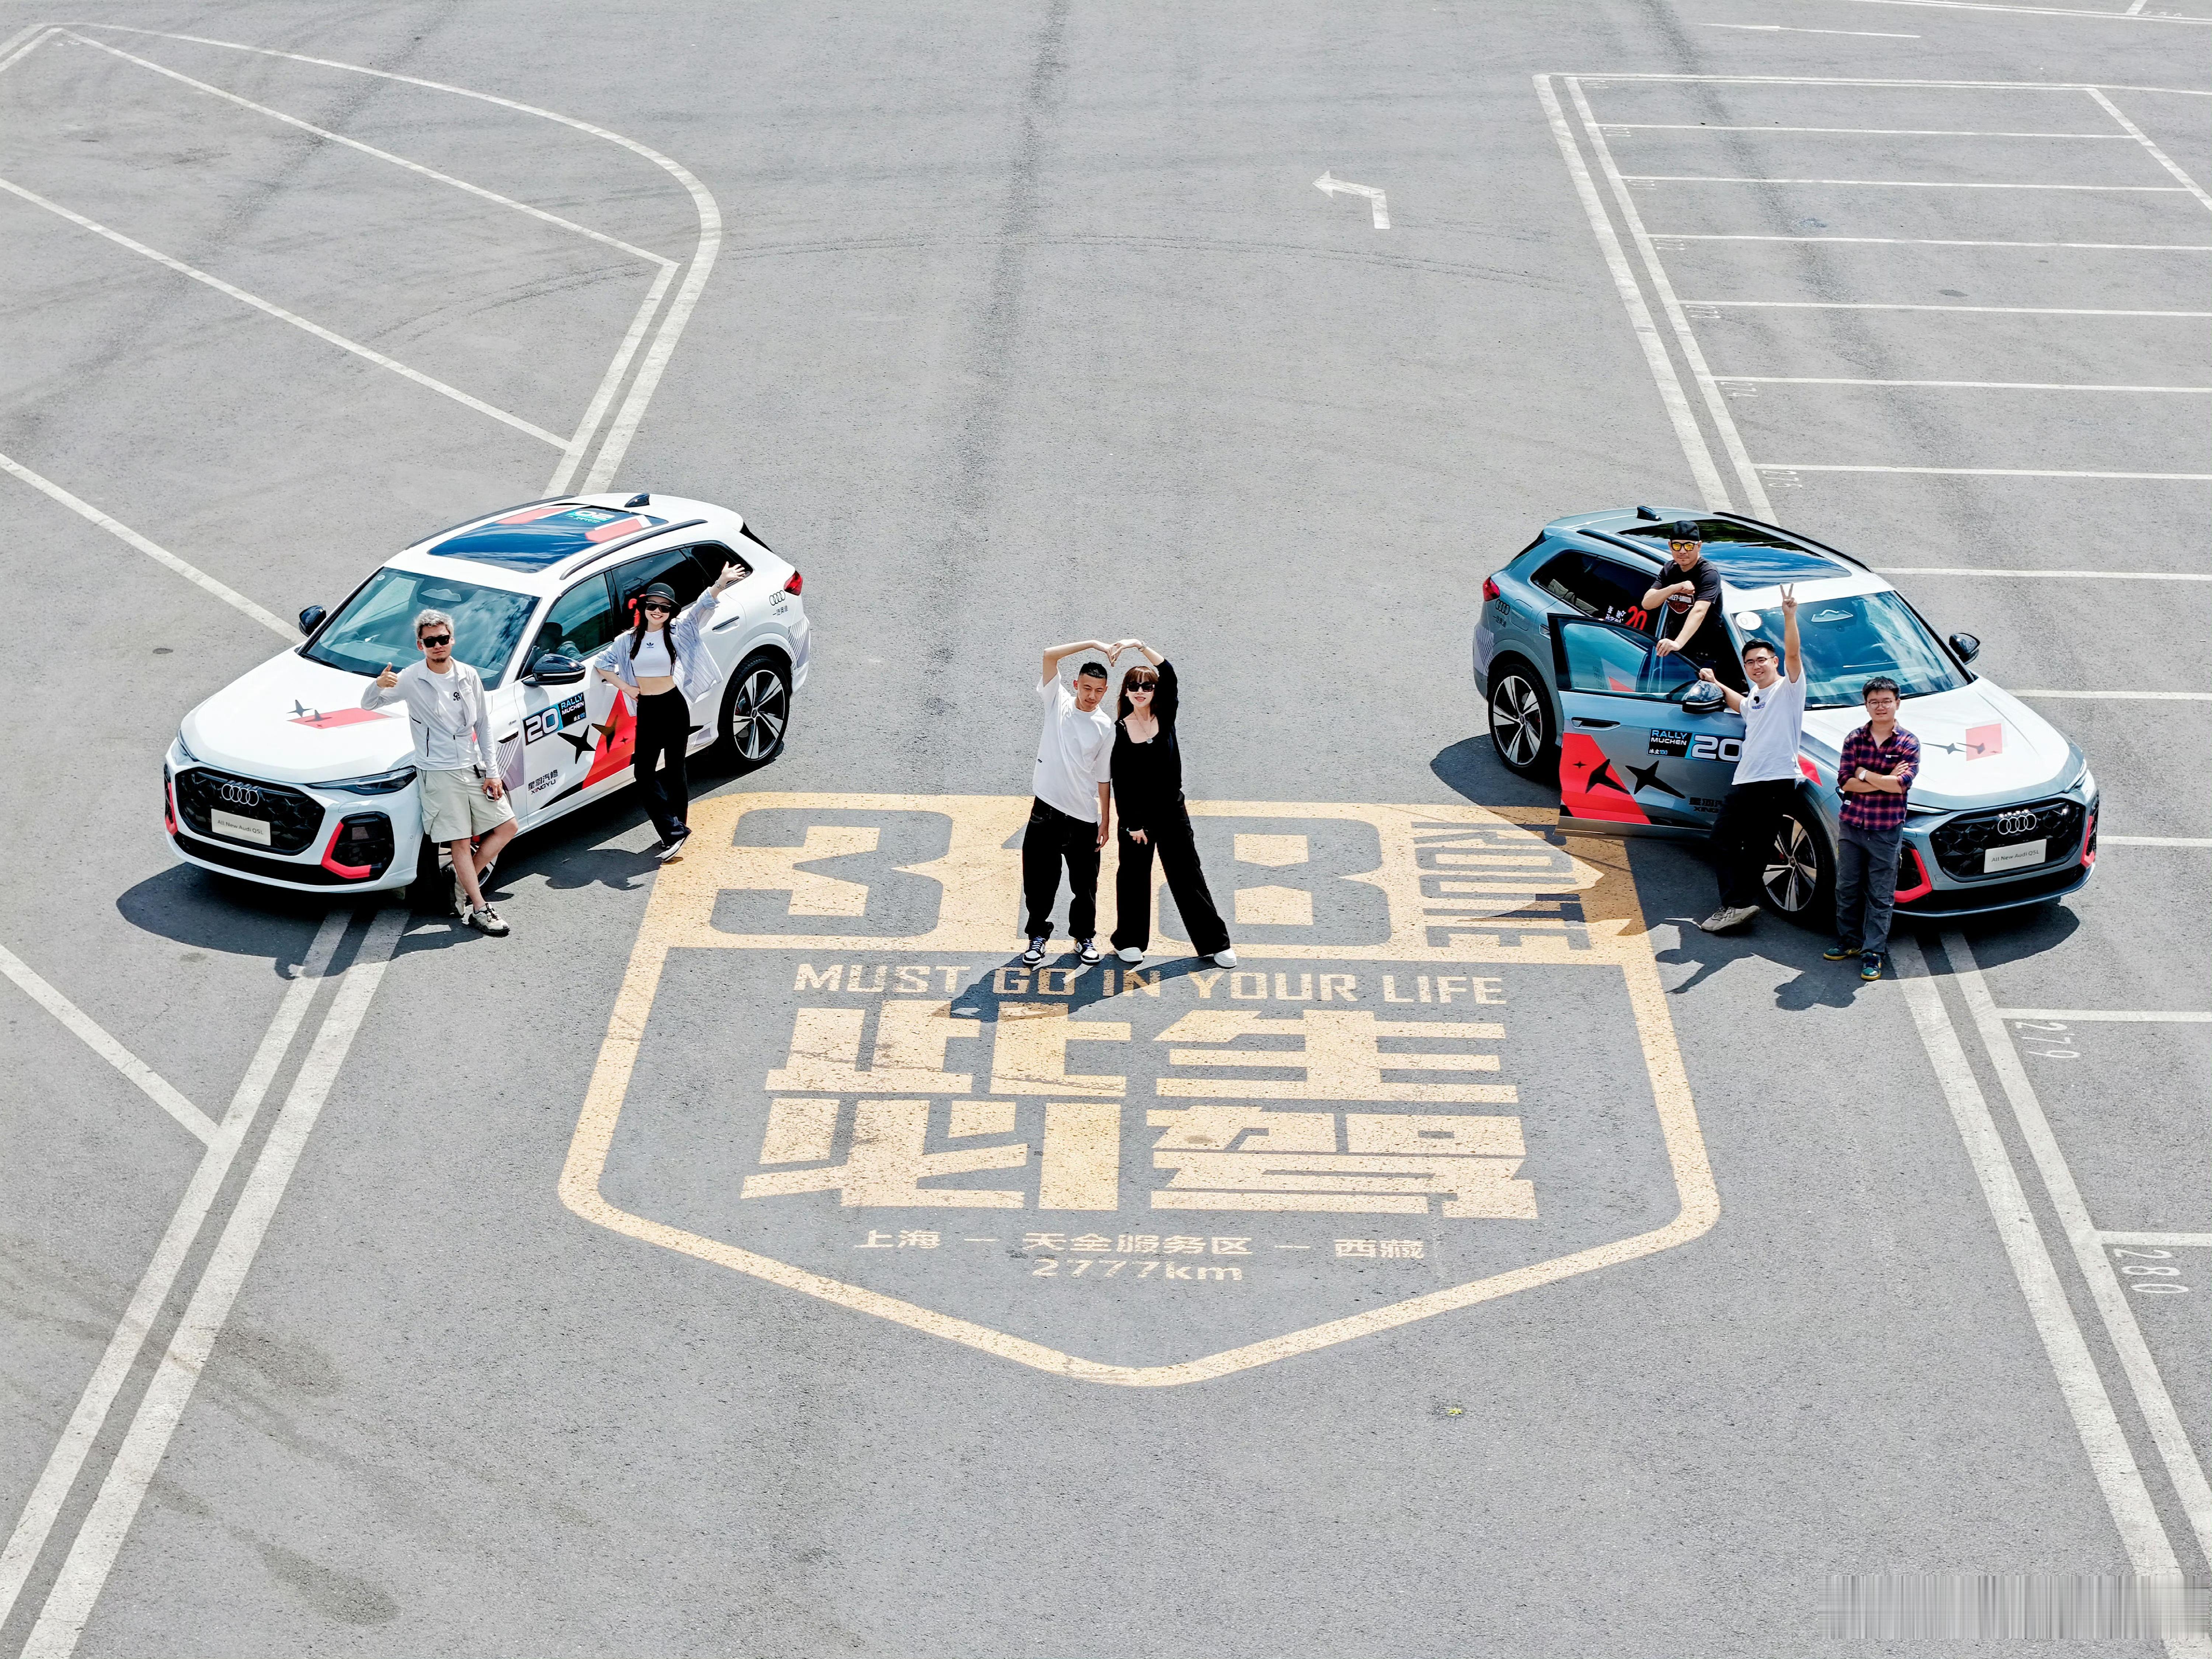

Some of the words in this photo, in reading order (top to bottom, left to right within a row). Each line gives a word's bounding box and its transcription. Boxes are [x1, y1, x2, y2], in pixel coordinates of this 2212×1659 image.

[1686, 305, 1721, 319] 273
[1720, 382, 1759, 397] 274
[1762, 470, 1803, 488] 275
[560, 693, 583, 709] RALLY
[561, 701, 584, 716] MUCHEN
[525, 708, 559, 742] 20
[1651, 730, 1687, 740] RALLY
[1651, 737, 1687, 745] MUCHEN
[1691, 735, 1743, 762] 20
[528, 769, 558, 791] 星羽汽修
[531, 779, 556, 795] XINGYU
[709, 807, 1393, 948] 38
[1410, 821, 1592, 950] ROUTE
[793, 963, 971, 993] MUST
[992, 967, 1076, 996] GO
[1103, 969, 1161, 998] IN
[1187, 971, 1359, 1002] YOUR
[1382, 975, 1508, 1005] LIFE
[2015, 1021, 2080, 1058] 279
[853, 1229, 942, 1249] 上海
[1022, 1232, 1252, 1255] 天全服务区
[1334, 1239, 1425, 1259] 西藏
[1032, 1258, 1243, 1281] 2777km
[2113, 1249, 2189, 1294] 280
